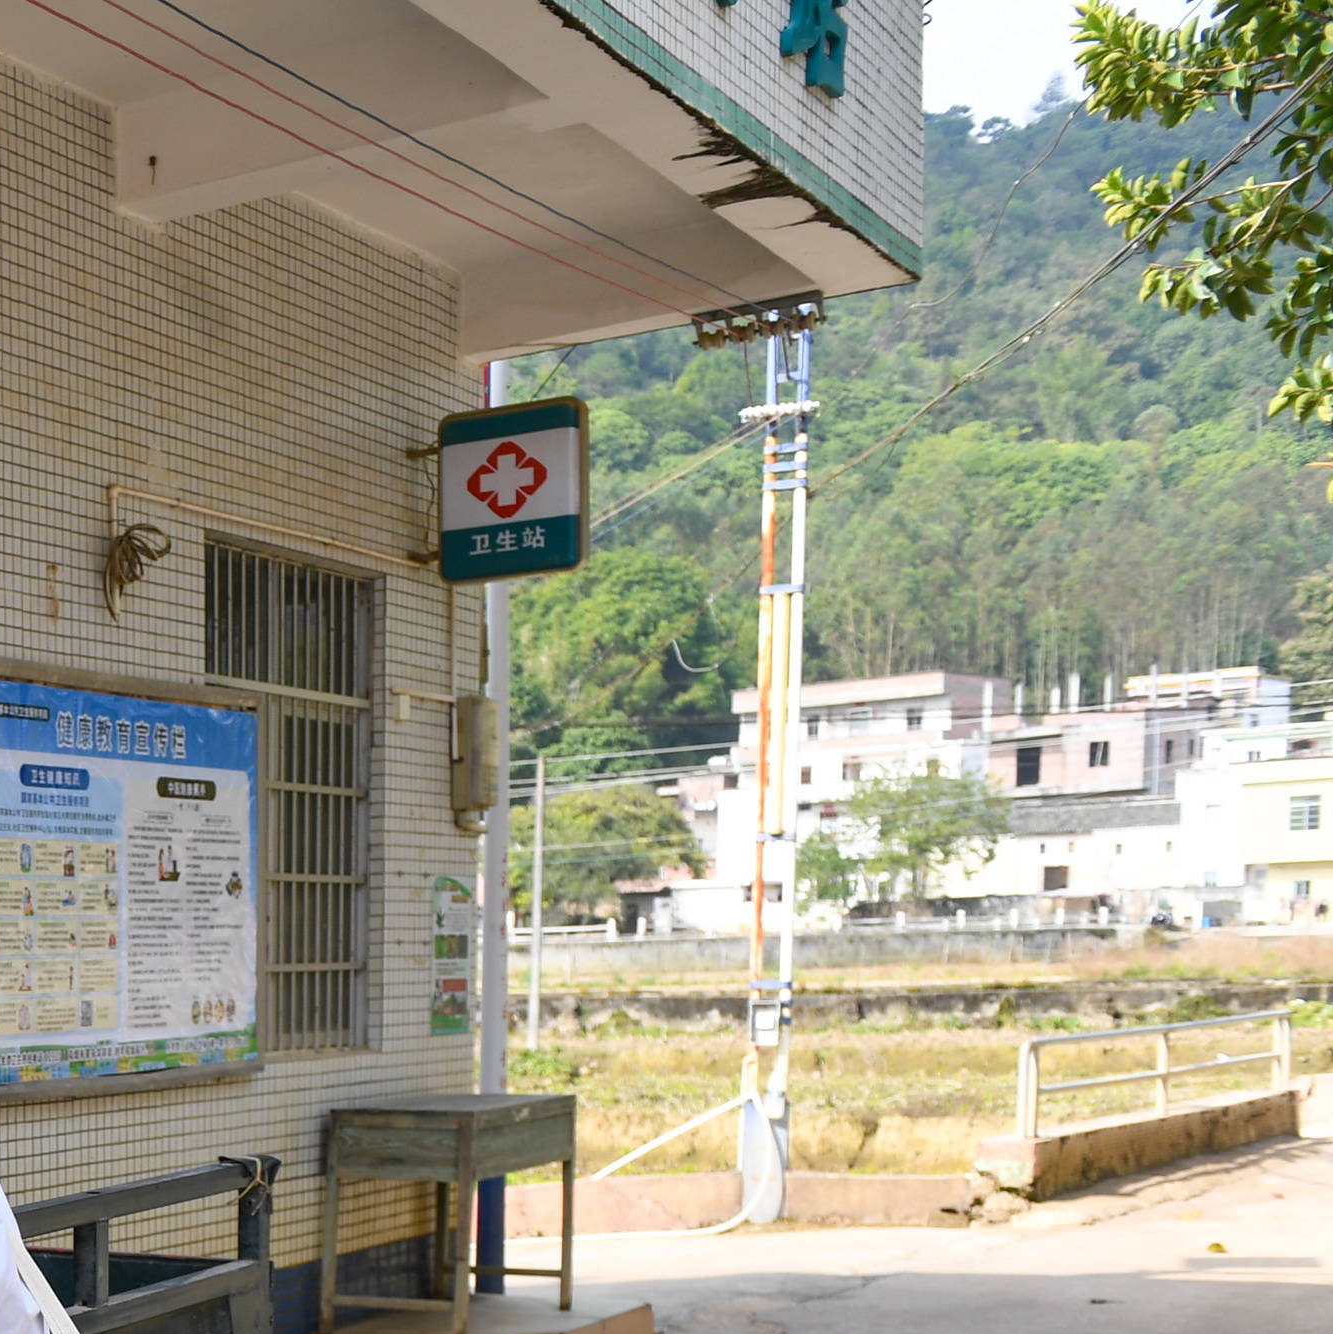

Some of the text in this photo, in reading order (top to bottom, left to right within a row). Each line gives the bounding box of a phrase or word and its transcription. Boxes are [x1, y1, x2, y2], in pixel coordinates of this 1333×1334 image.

[469, 526, 546, 556] 卫生站
[56, 709, 187, 759] 健康教育宣传栏
